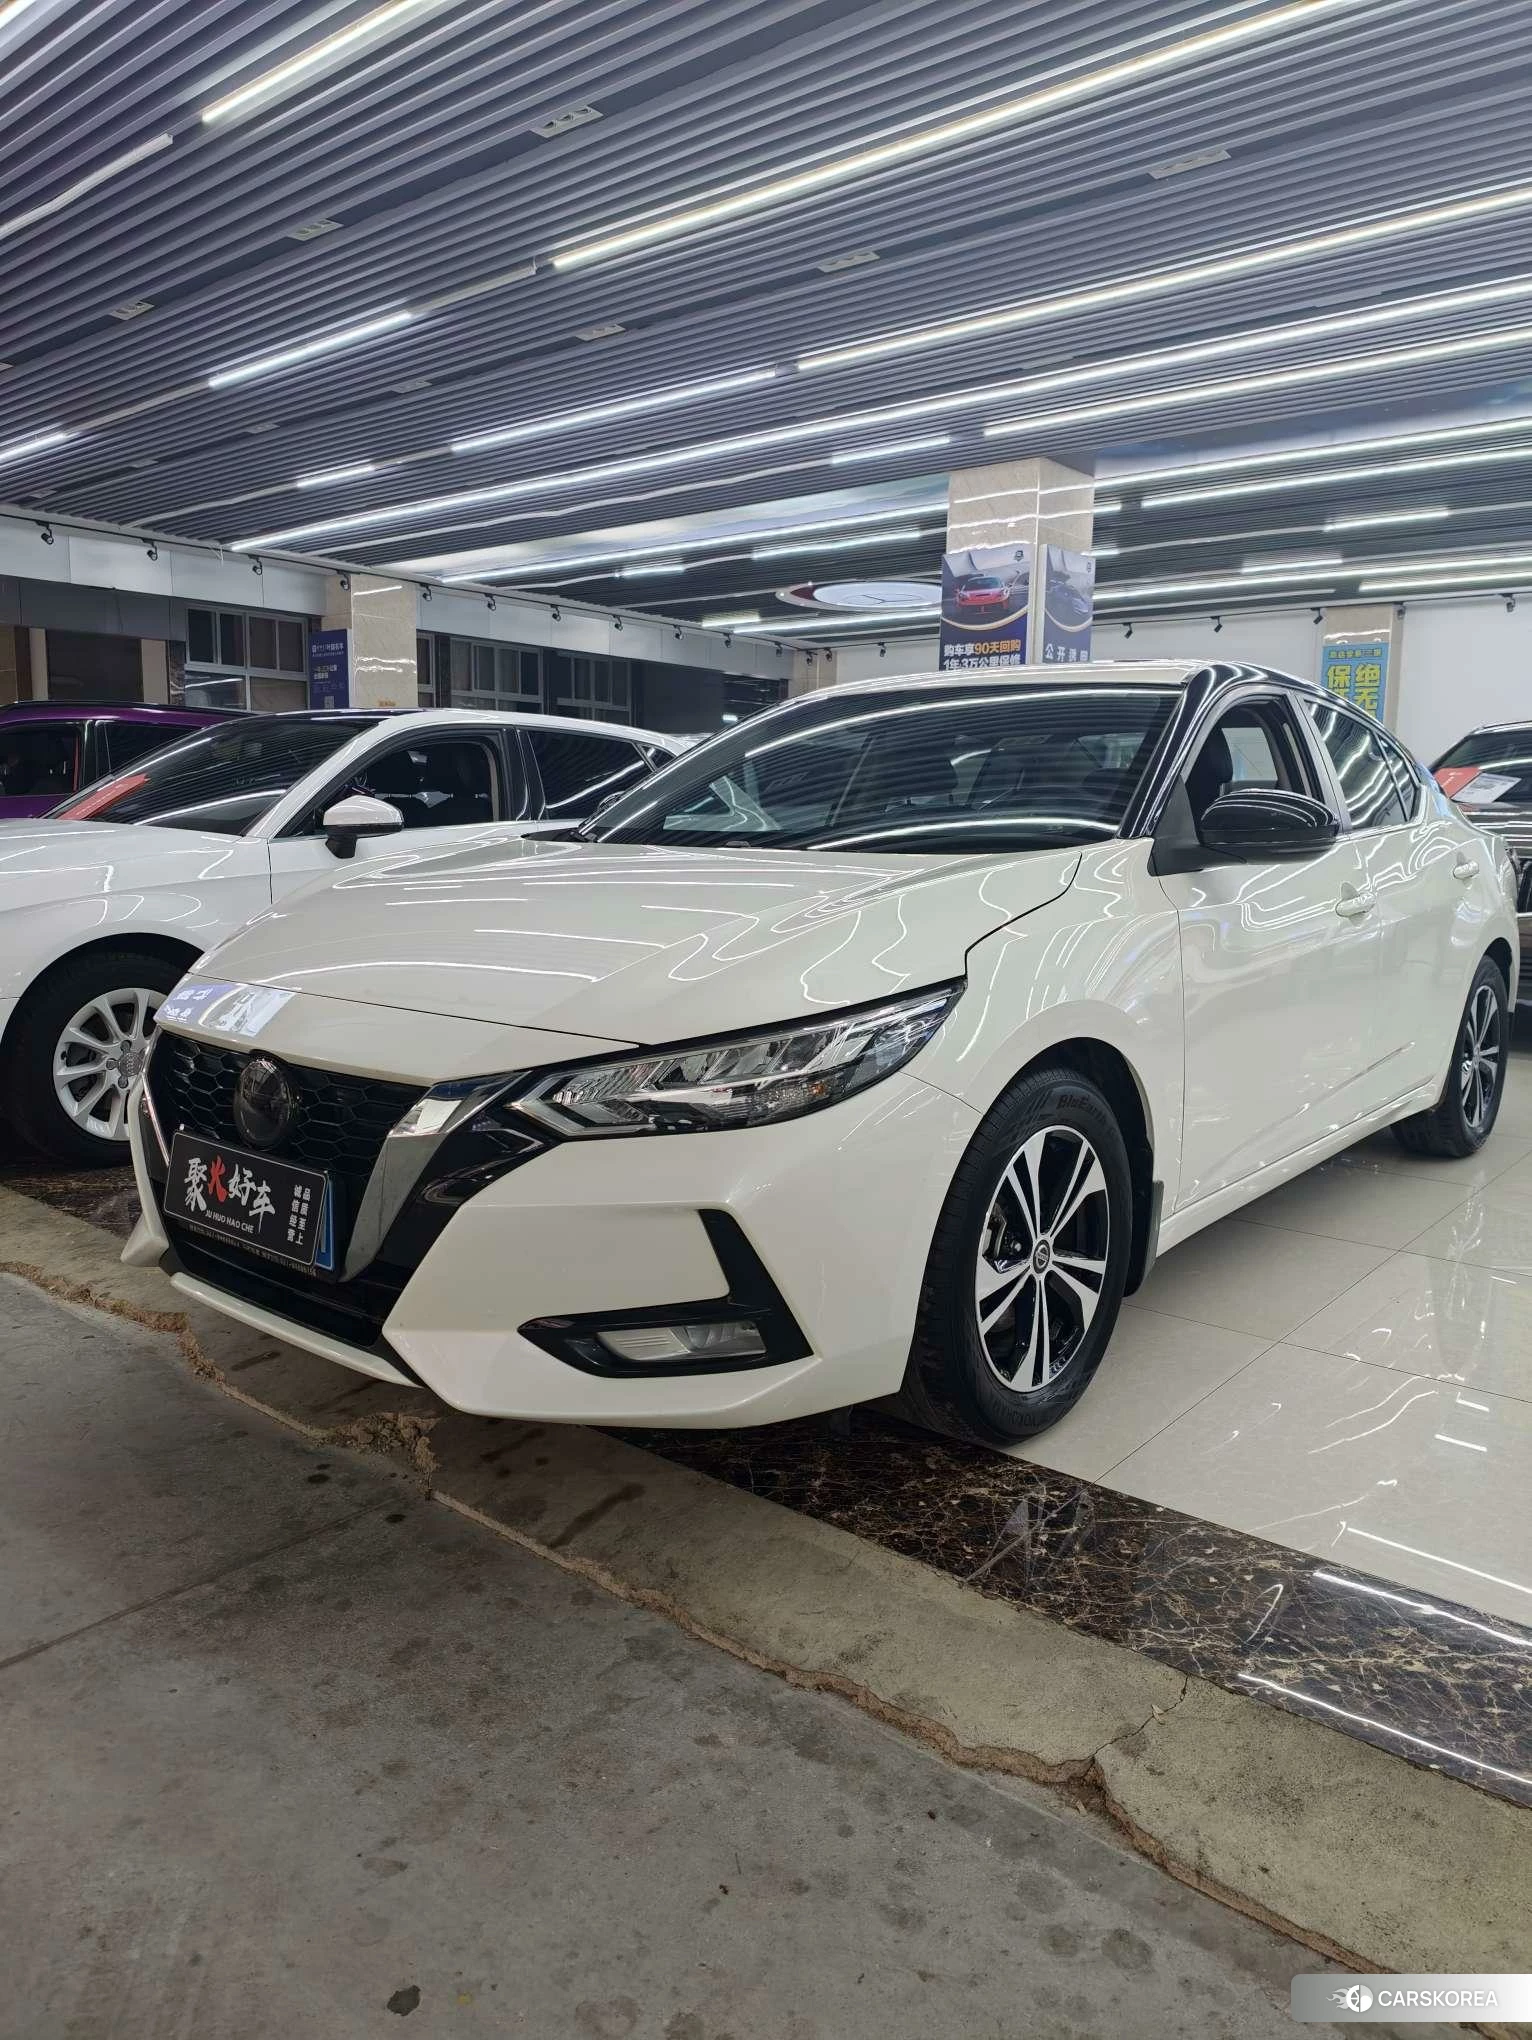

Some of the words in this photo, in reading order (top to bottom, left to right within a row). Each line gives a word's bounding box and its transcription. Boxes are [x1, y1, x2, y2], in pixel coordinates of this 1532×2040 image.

[944, 639, 1021, 657] 购车享90天回购
[184, 1154, 275, 1233] 聚火好车
